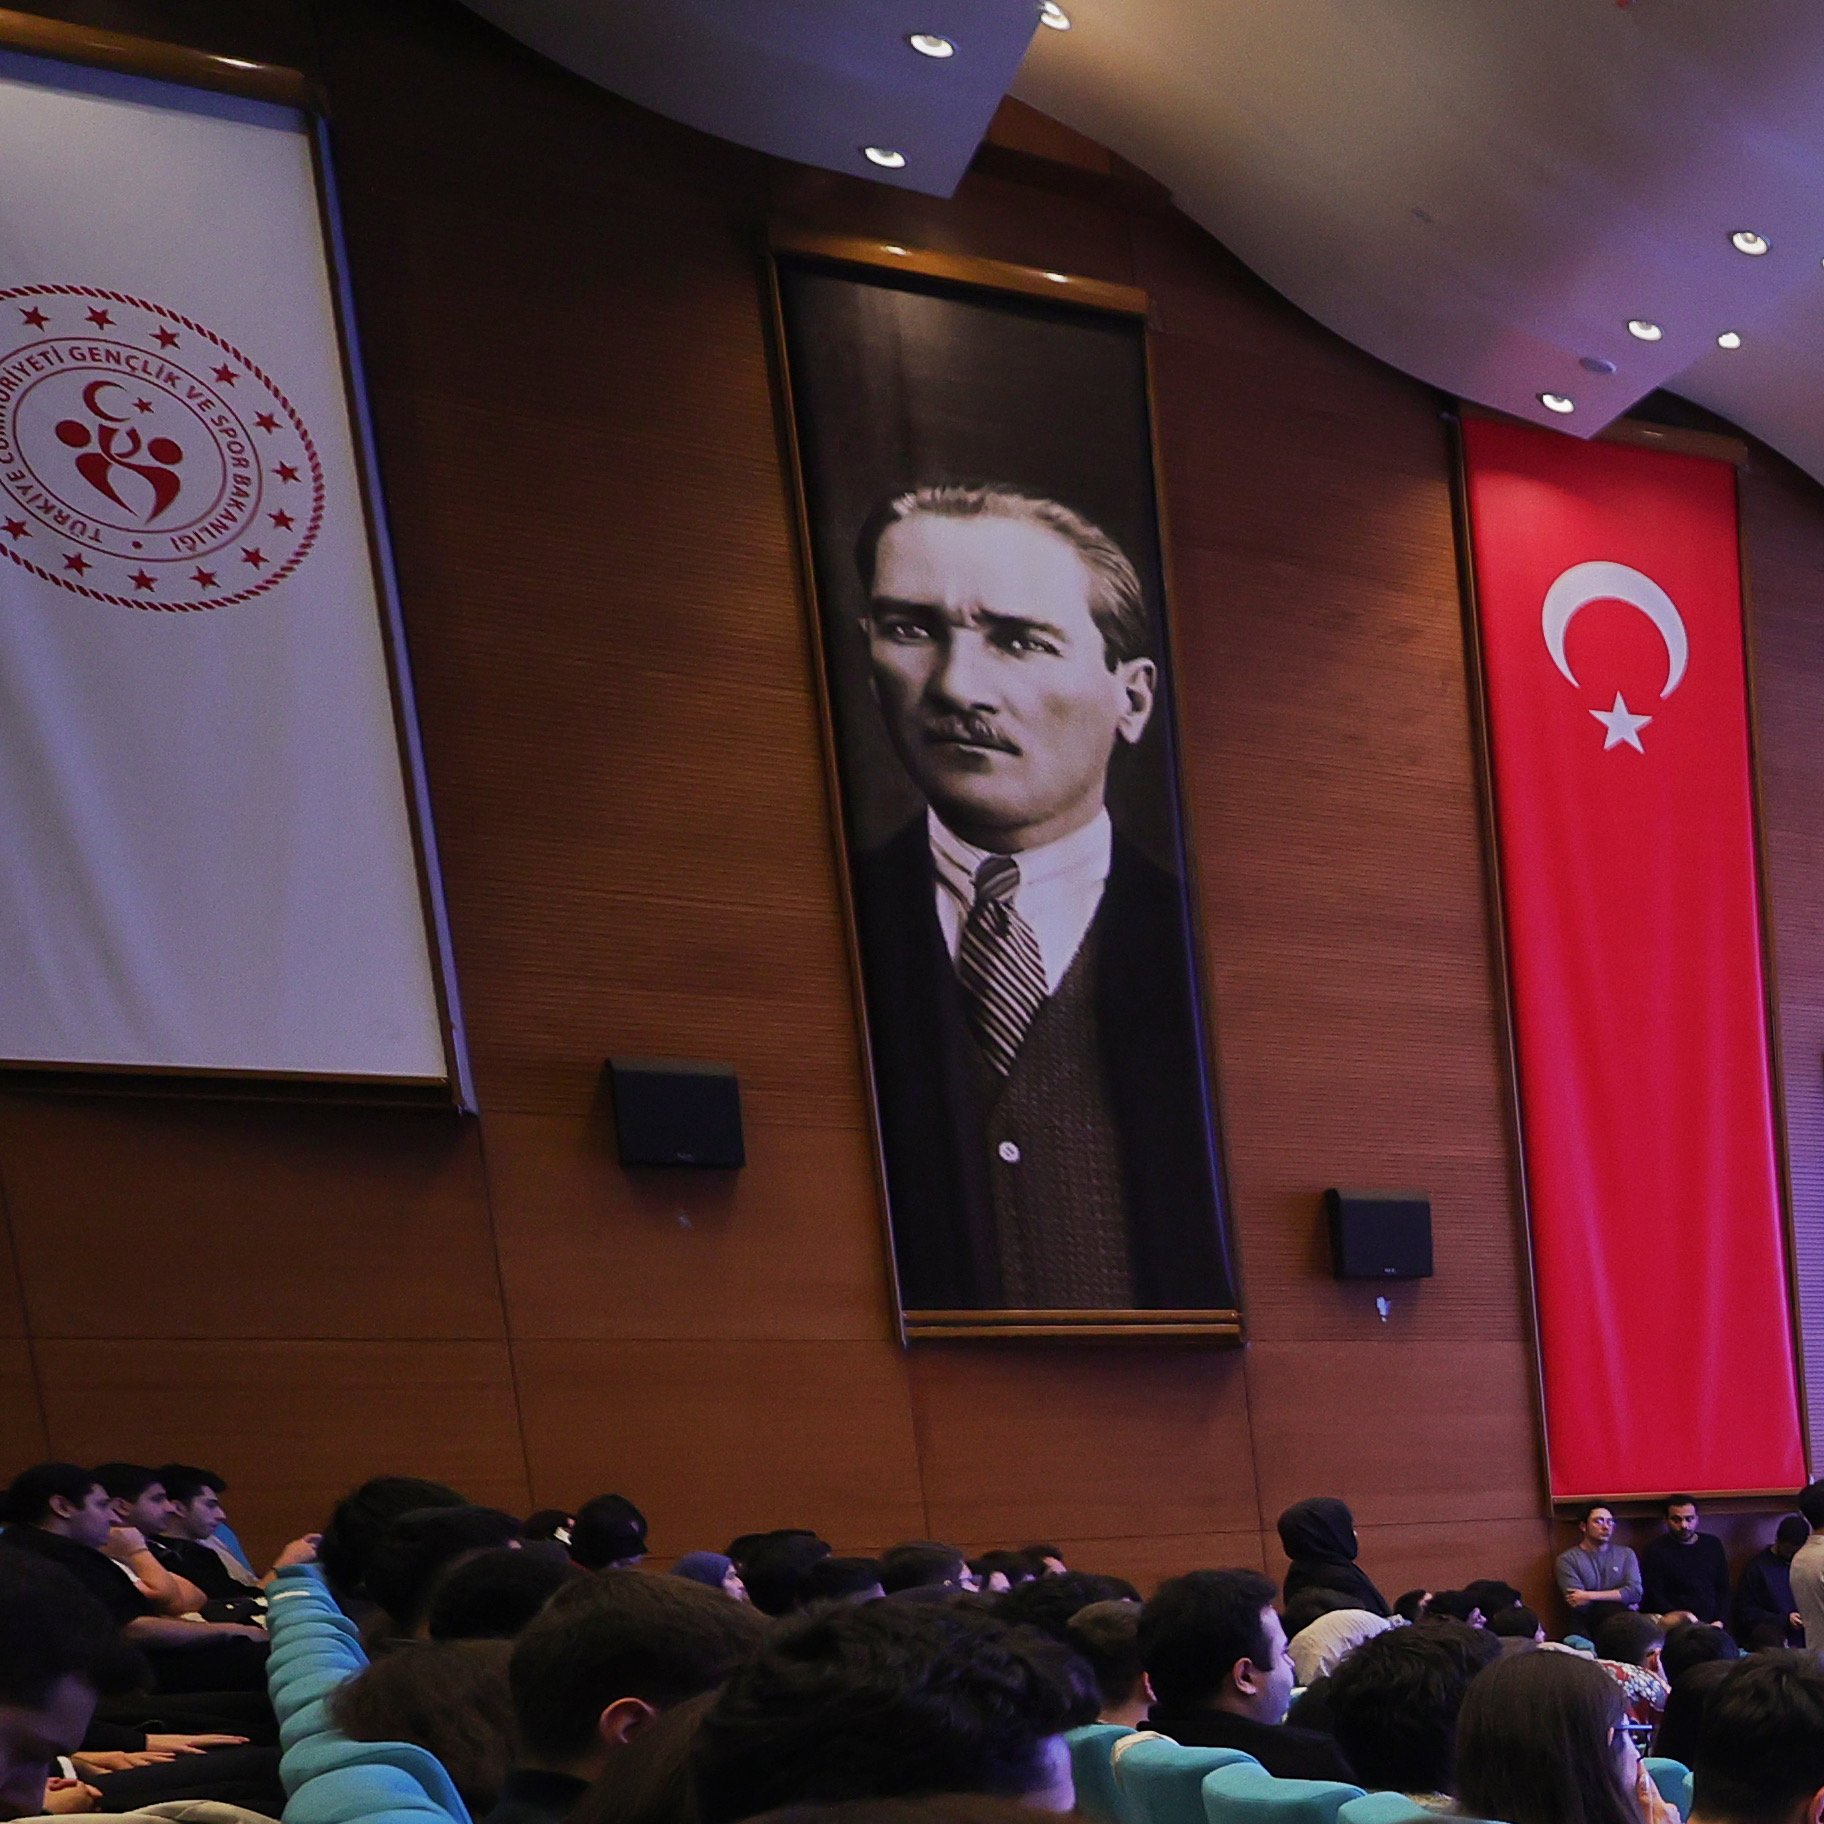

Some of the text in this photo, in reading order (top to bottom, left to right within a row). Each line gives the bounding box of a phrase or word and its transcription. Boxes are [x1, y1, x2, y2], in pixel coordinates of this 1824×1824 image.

[68, 346, 181, 389] GENÇLİK
[186, 385, 216, 412] VE
[211, 414, 250, 469] SPOR
[6, 469, 103, 543] TÜRKİYE
[170, 473, 251, 553] BAKANLIĞI
